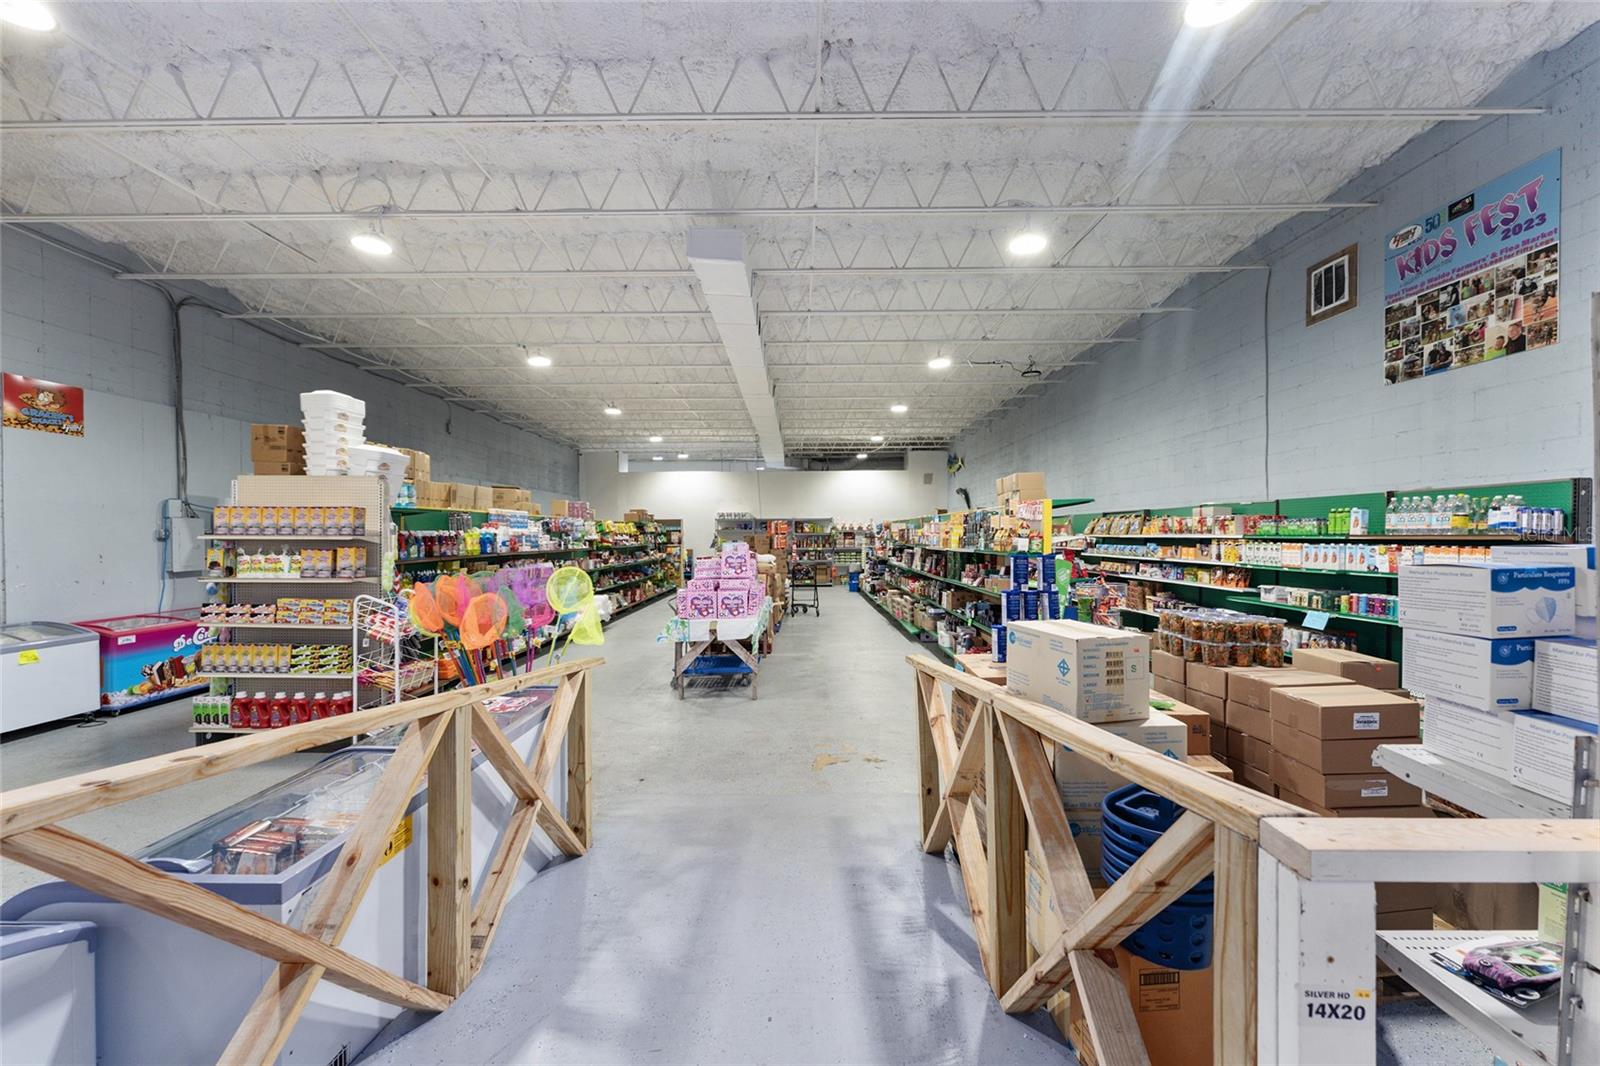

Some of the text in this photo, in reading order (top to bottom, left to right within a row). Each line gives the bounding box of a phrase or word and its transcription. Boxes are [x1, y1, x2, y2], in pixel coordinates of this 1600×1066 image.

[1395, 175, 1544, 281] KIDS FEST
[1501, 213, 1546, 241] 2023
[1500, 243, 1520, 257] Flea
[1522, 227, 1558, 248] Market
[1513, 570, 1543, 579] Particulate
[1131, 664, 1137, 673] S
[1304, 990, 1336, 999] SILVER
[1337, 991, 1350, 1000] HD
[1307, 1003, 1366, 1021] 14X20
